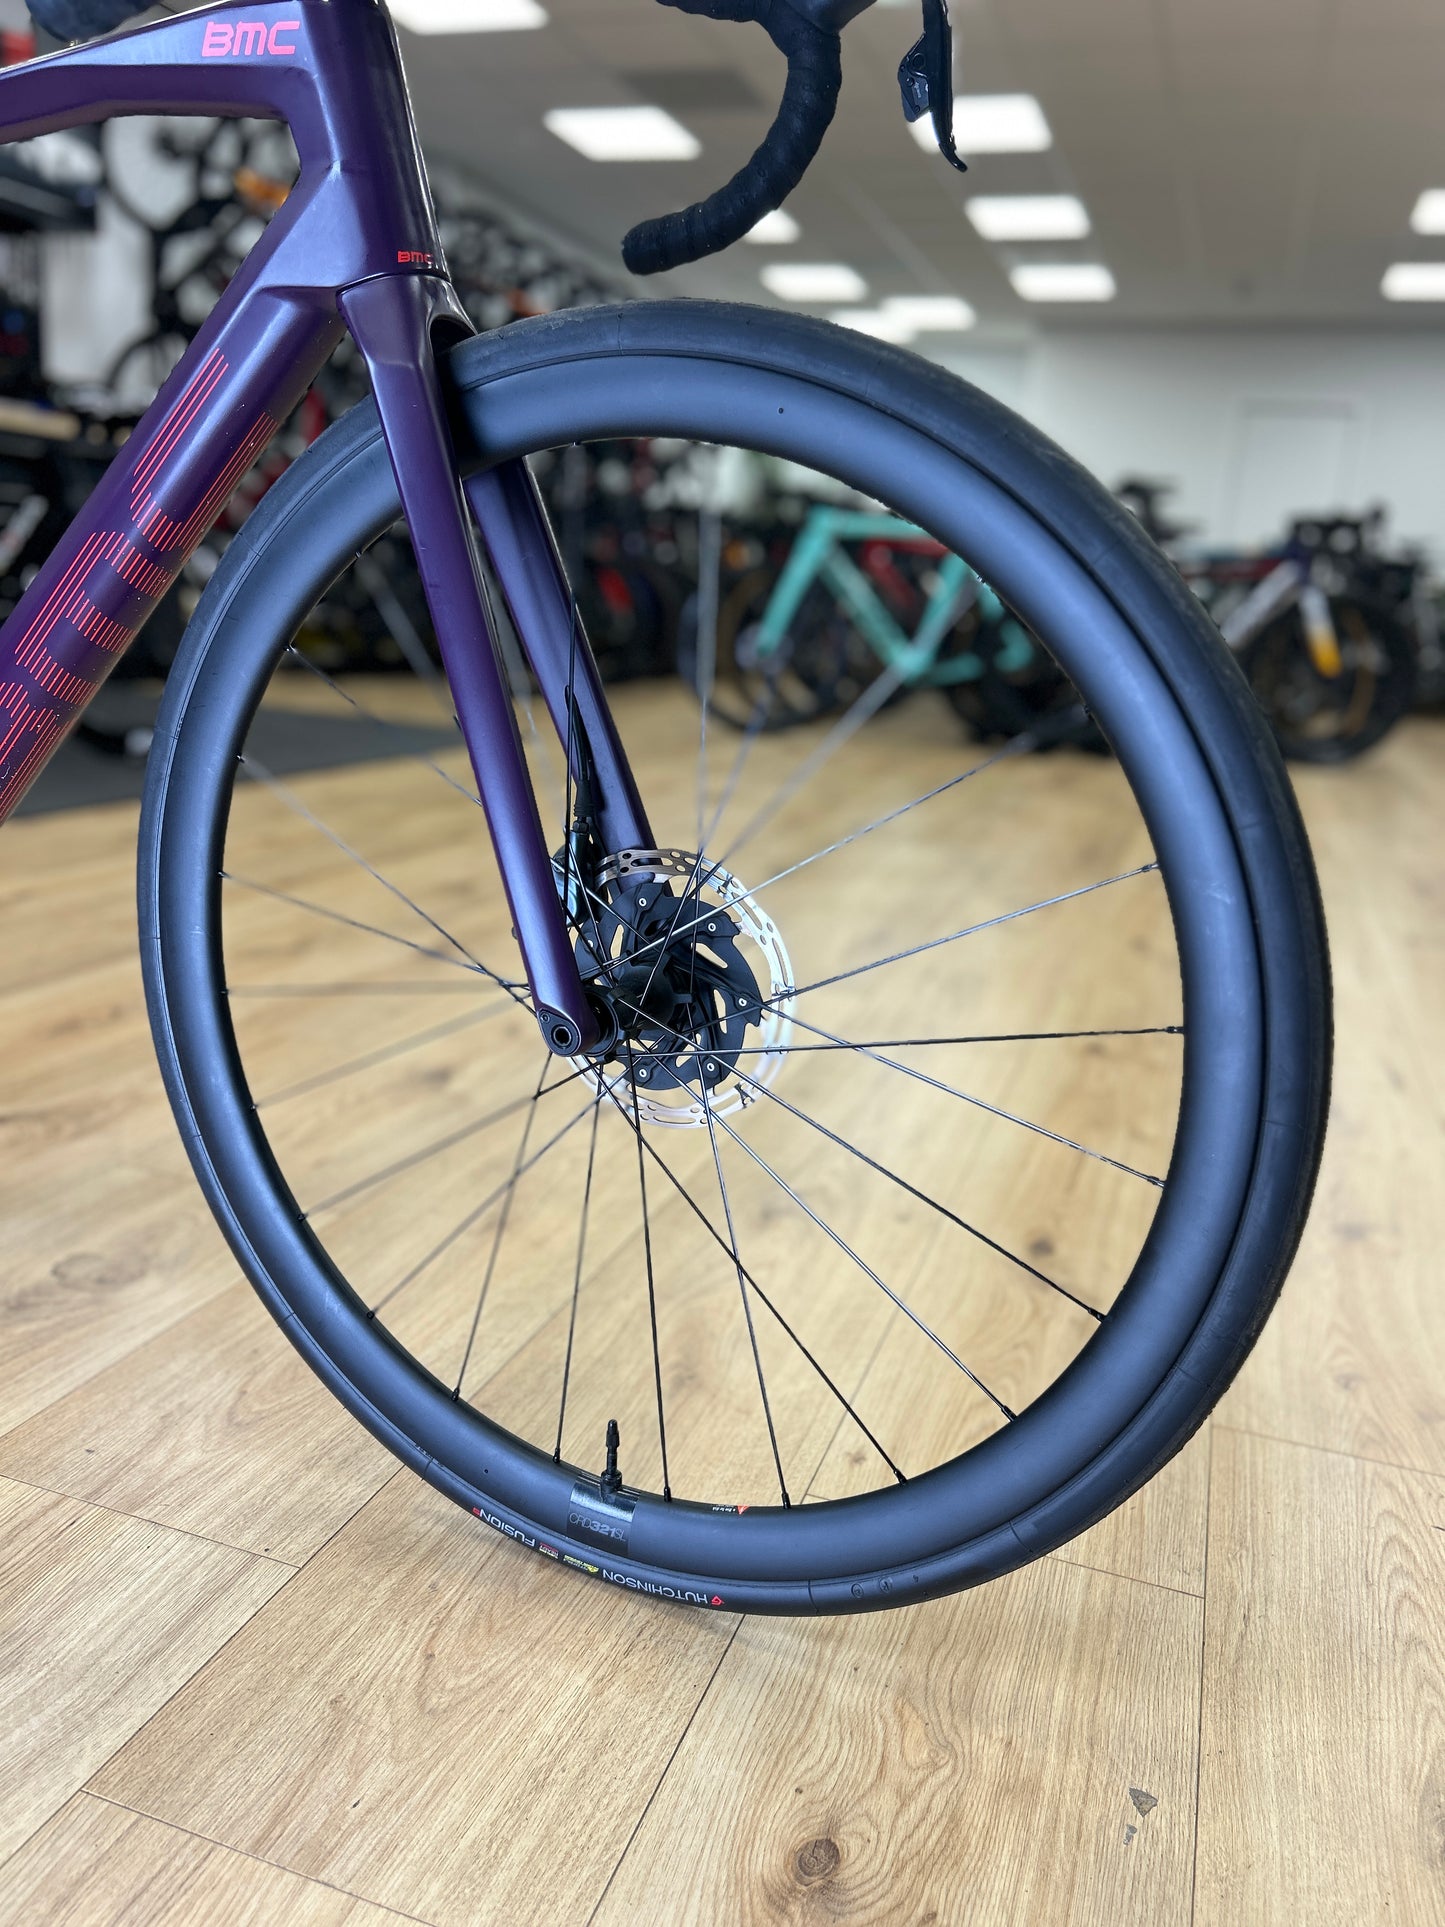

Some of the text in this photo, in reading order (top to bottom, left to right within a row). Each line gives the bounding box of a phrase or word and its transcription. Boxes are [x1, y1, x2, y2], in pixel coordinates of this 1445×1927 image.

[202, 21, 300, 57] BMC
[397, 250, 433, 264] BMC
[602, 1568, 708, 1605] HUTCHINSON
